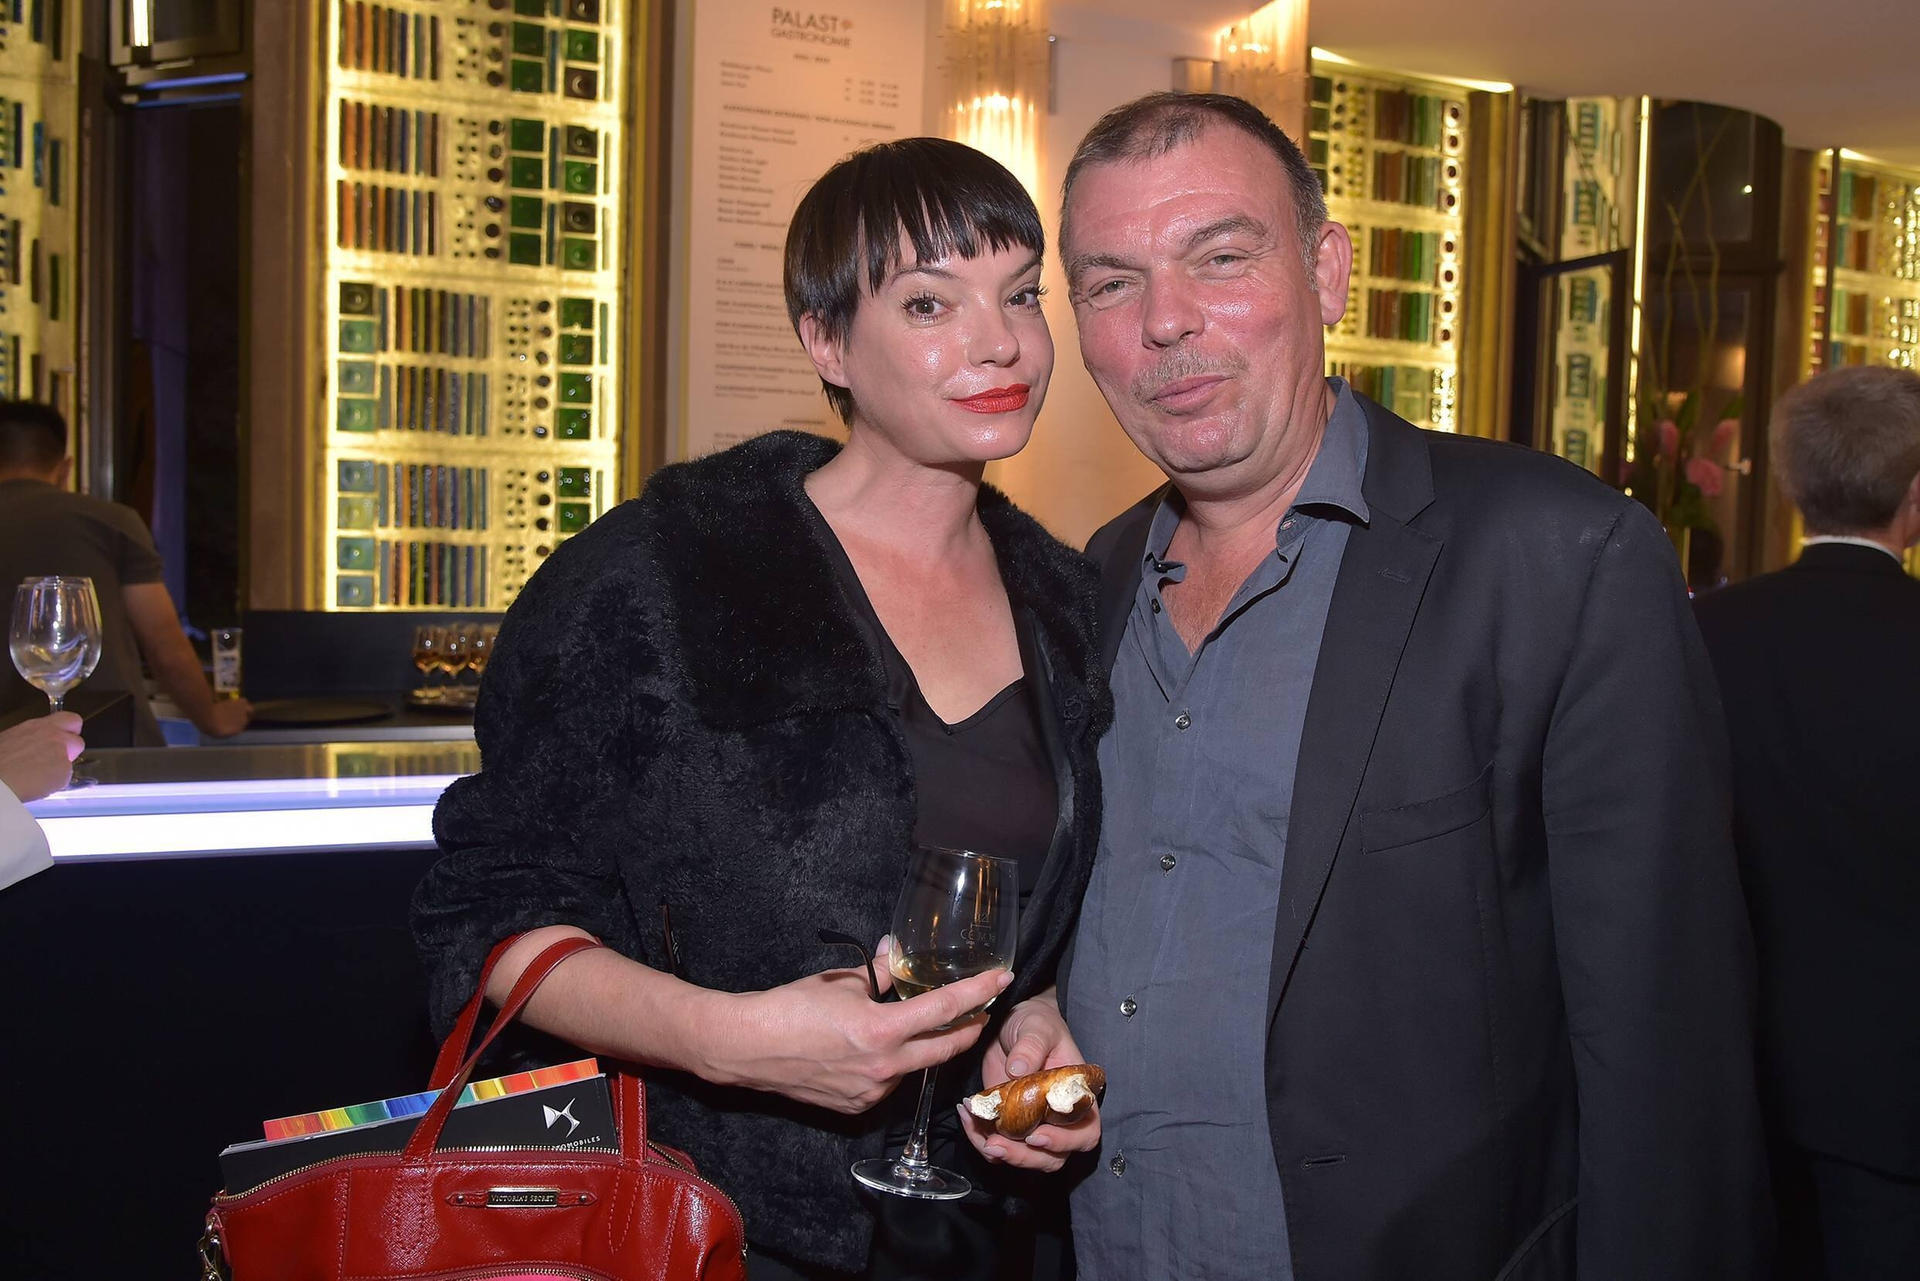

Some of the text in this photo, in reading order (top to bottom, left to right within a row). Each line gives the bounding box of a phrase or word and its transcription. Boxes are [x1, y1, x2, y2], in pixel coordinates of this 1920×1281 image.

[772, 7, 838, 33] PALAST
[771, 28, 851, 48] GASTRONOMIE
[490, 1194, 554, 1202] VICTORIA'S SECRET
